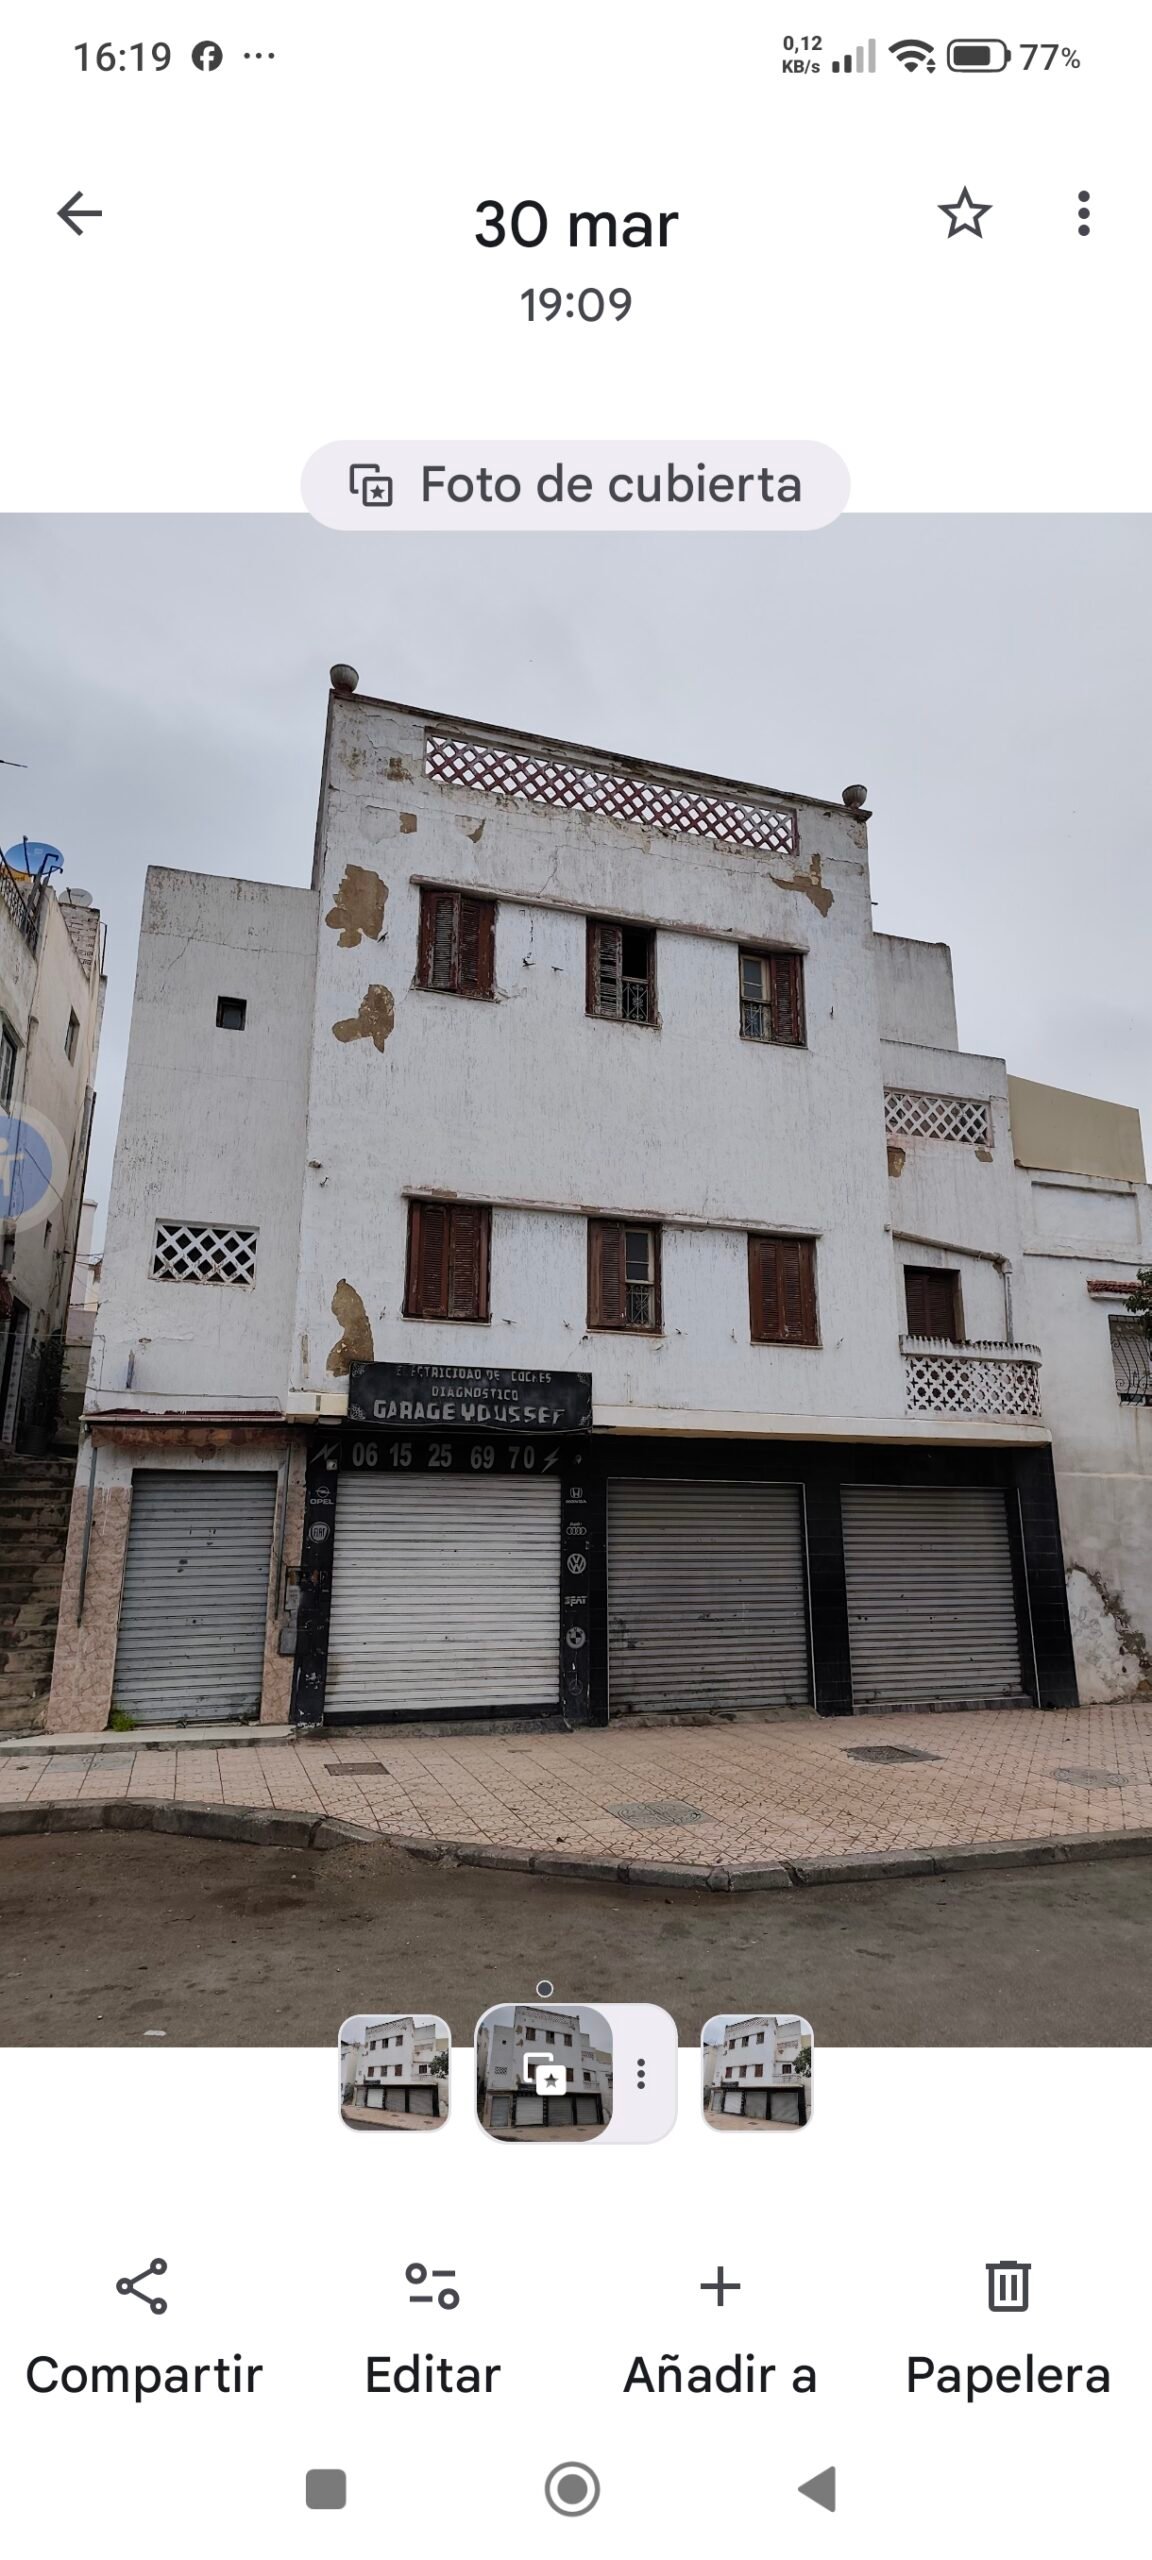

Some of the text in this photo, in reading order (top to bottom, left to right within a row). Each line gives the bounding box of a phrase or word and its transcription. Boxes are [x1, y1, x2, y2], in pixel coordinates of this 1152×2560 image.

[431, 1386, 519, 1401] DIAGNOSTICO
[373, 1399, 456, 1421] GARAGE
[352, 1441, 536, 1470] 06 15 25 69 70
